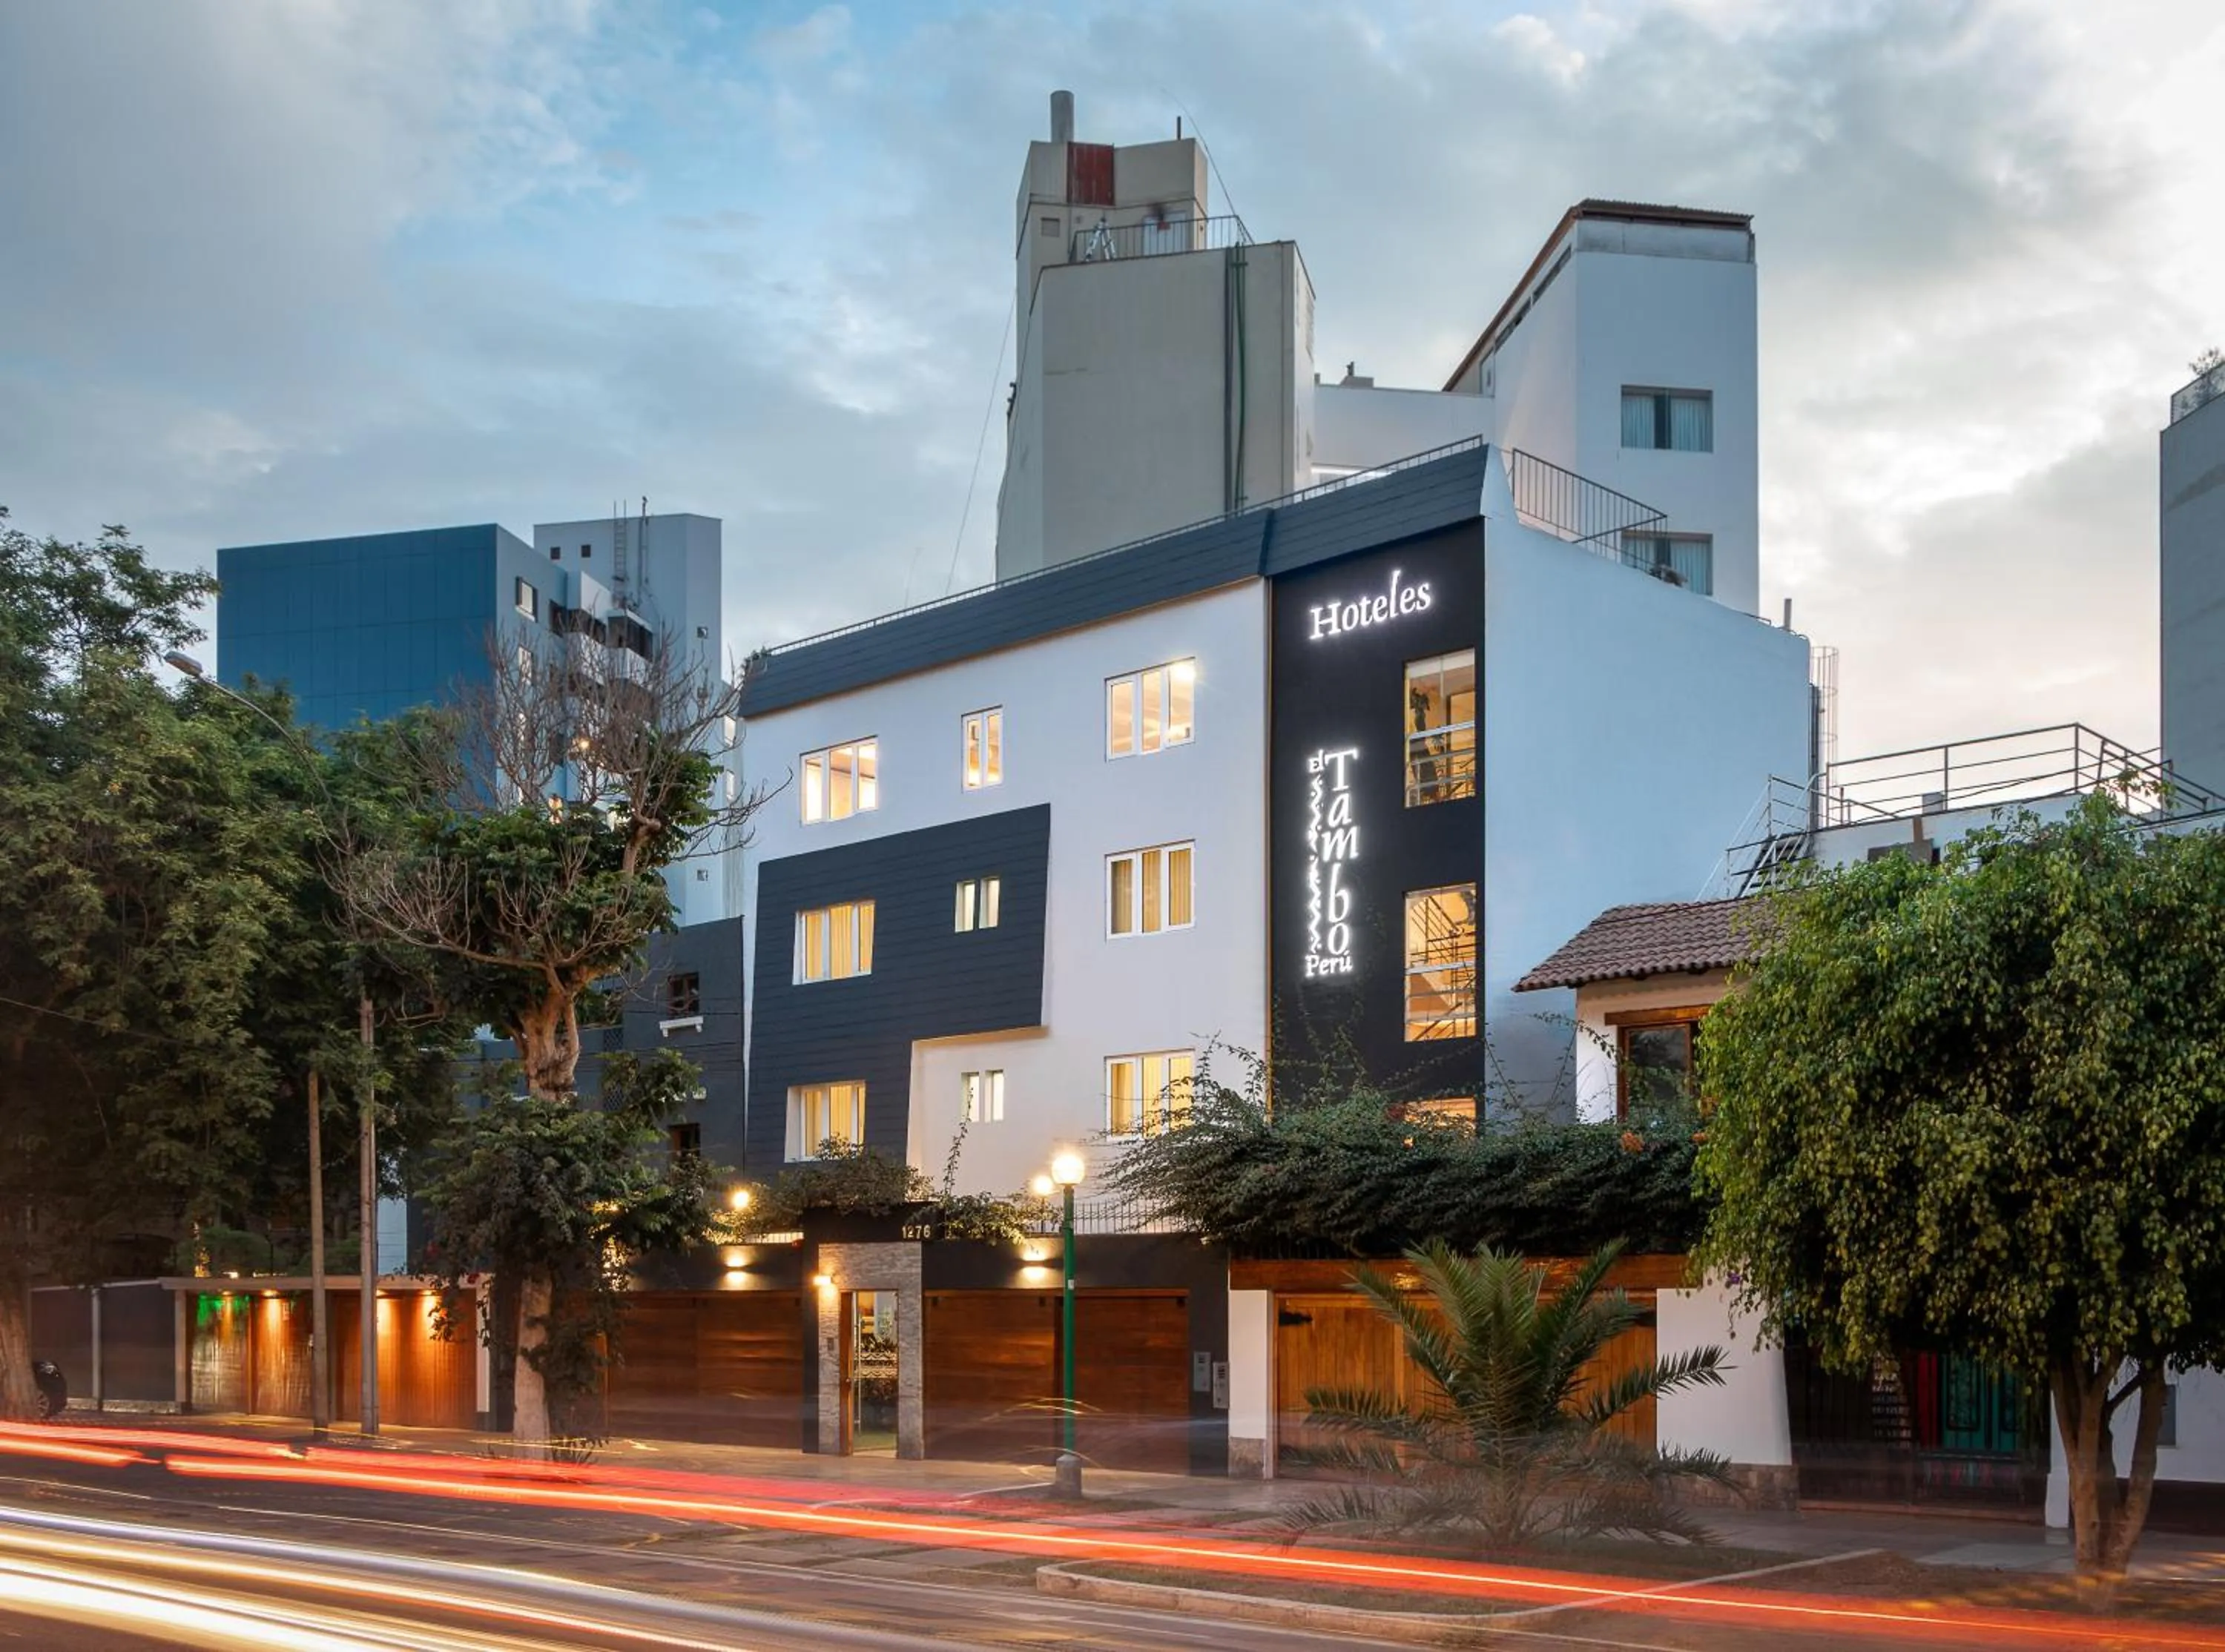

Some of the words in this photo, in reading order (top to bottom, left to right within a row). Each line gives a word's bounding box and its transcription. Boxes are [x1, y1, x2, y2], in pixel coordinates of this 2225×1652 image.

[1309, 569, 1431, 640] Hoteles
[1308, 749, 1324, 773] El
[1322, 748, 1359, 955] Tambo
[1305, 951, 1353, 977] Perú
[902, 1224, 931, 1239] 1276
